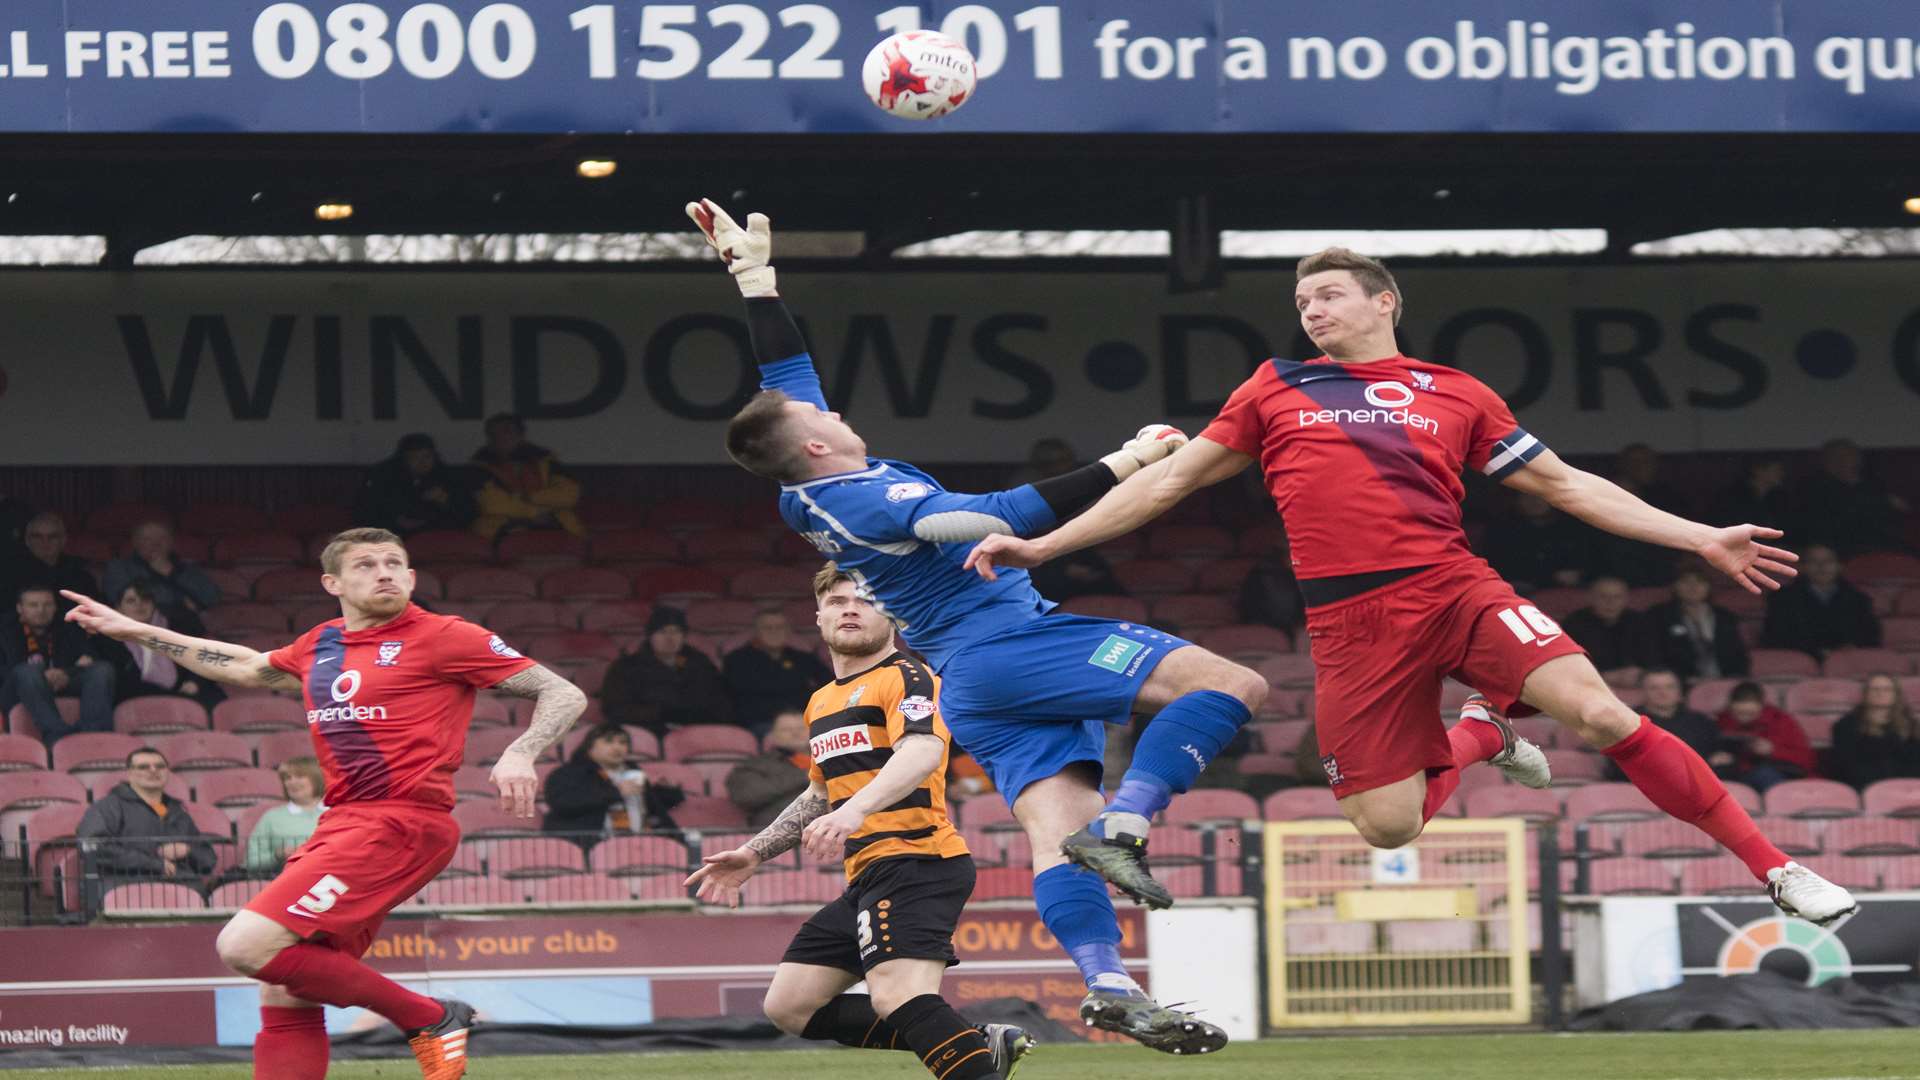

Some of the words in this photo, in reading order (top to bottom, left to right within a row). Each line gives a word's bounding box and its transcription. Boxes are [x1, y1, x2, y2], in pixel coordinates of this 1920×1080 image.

[0, 31, 48, 78] L
[65, 31, 231, 78] FREE
[252, 2, 537, 79] 0800
[569, 4, 844, 79] 1522
[1095, 19, 1207, 80] for
[1223, 37, 1268, 80] a
[1288, 37, 1387, 80] no
[1405, 20, 1796, 95] obligation
[919, 52, 969, 74] mitre
[115, 312, 1056, 421] WINDOWS
[1160, 302, 1768, 412] DORS
[1299, 408, 1439, 435] benenden
[1497, 605, 1562, 645] 16
[1102, 641, 1130, 665] BMI
[1126, 647, 1154, 677] Healthcare
[307, 703, 387, 724] enenden
[811, 730, 869, 758] OSHIBA
[1181, 744, 1208, 773] JAKO
[1383, 853, 1409, 877] 4
[296, 873, 350, 913] 5
[455, 936, 535, 961] your
[543, 929, 620, 953] club
[951, 921, 1022, 951] OW
[68, 1024, 128, 1045] facility
